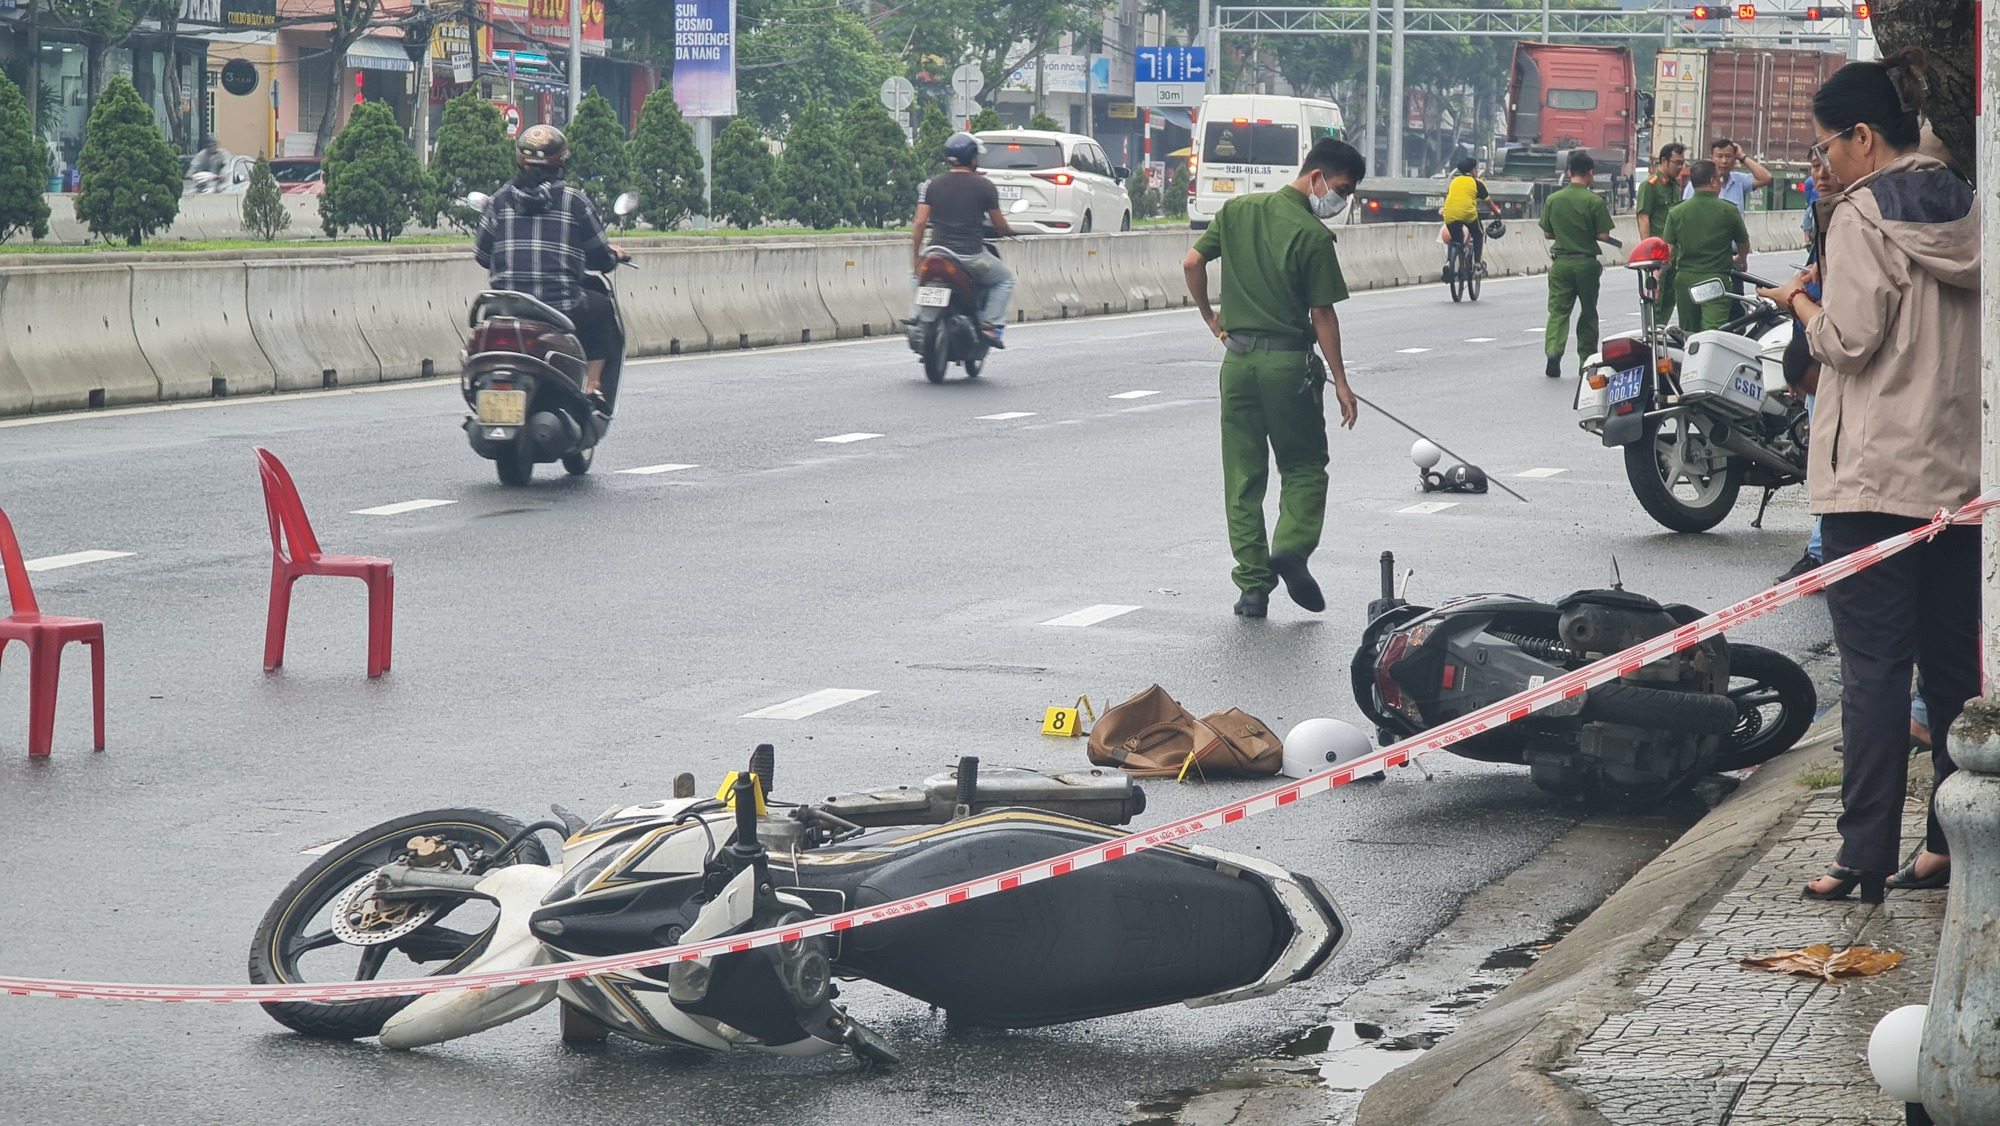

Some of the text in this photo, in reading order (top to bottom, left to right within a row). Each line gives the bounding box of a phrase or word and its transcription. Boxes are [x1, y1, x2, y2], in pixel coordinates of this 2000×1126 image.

[676, 4, 697, 17] SUN
[1739, 7, 1754, 18] 60
[676, 18, 713, 31] COSMO
[676, 33, 730, 46] RESIDENCE
[676, 47, 720, 60] DA NANG
[1160, 91, 1180, 100] 30m
[1226, 165, 1272, 175] 92B-016.35
[1613, 369, 1639, 387] 43-AT
[1609, 382, 1639, 403] 000.15
[1735, 377, 1762, 400] CSGT
[1052, 711, 1066, 730] 8
